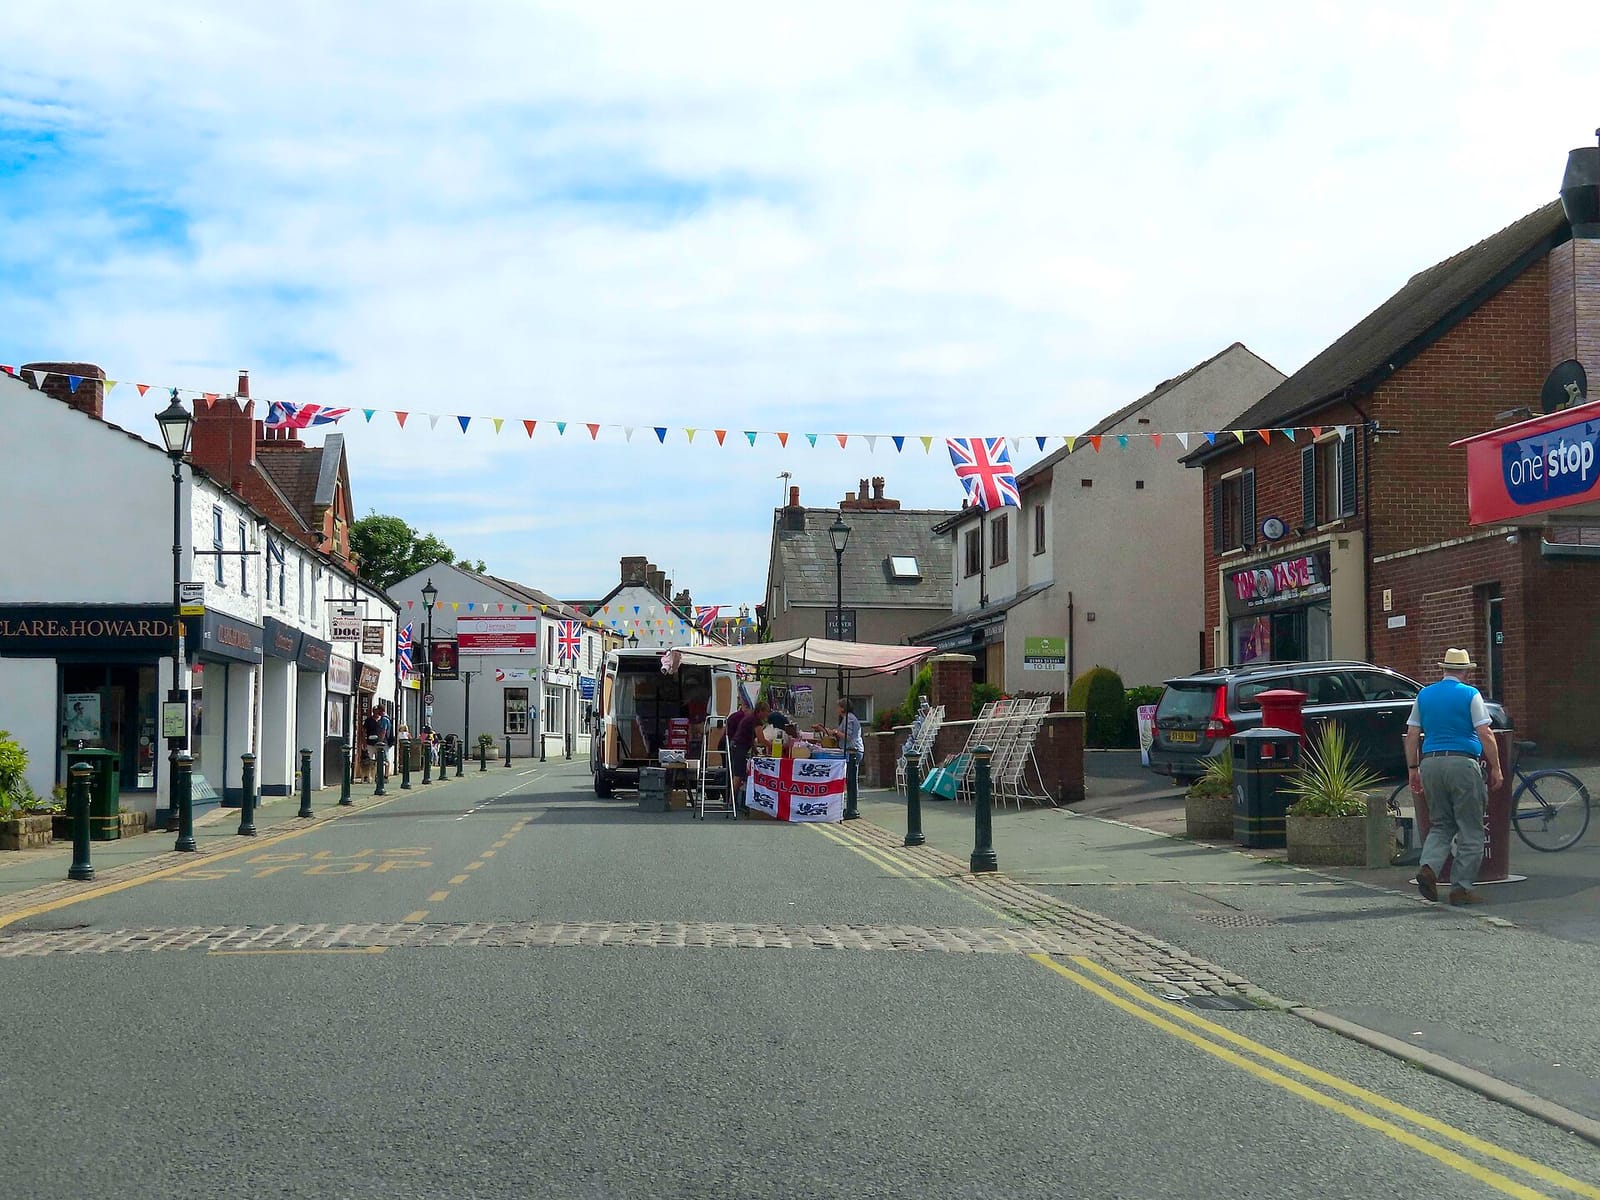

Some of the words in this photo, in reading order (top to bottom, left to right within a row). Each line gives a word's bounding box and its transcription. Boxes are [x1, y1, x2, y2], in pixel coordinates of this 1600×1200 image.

[1510, 455, 1543, 486] one
[1548, 439, 1594, 481] stop
[1272, 556, 1316, 592] TASTE
[333, 628, 360, 636] DOG
[246, 847, 433, 864] BUS
[159, 860, 434, 881] STOP
